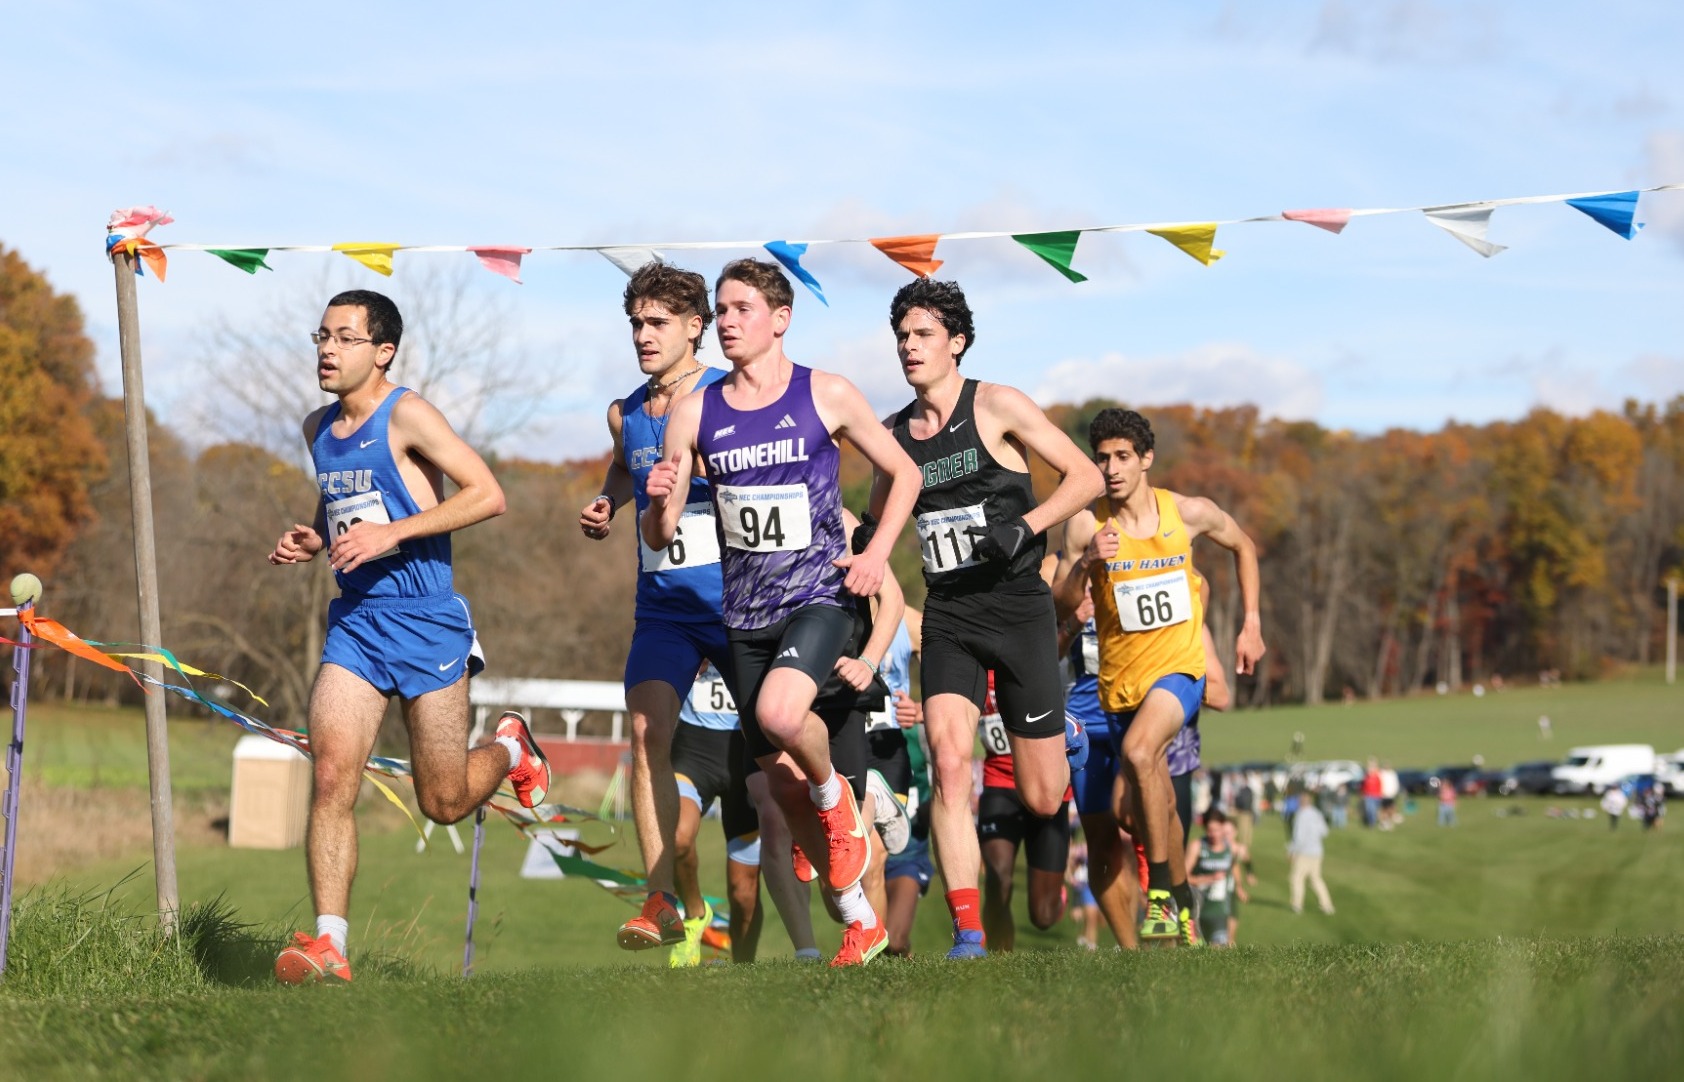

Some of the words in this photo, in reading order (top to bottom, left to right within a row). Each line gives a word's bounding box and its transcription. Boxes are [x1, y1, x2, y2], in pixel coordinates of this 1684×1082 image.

[708, 438, 809, 475] STONEHILL
[919, 448, 979, 490] GNER
[318, 470, 372, 494] CCSU
[752, 491, 804, 500] CHAMPIONSHIPS
[740, 506, 785, 548] 94
[1105, 560, 1135, 572] NEW
[1139, 555, 1186, 570] HAVEN
[1136, 590, 1173, 626] 66
